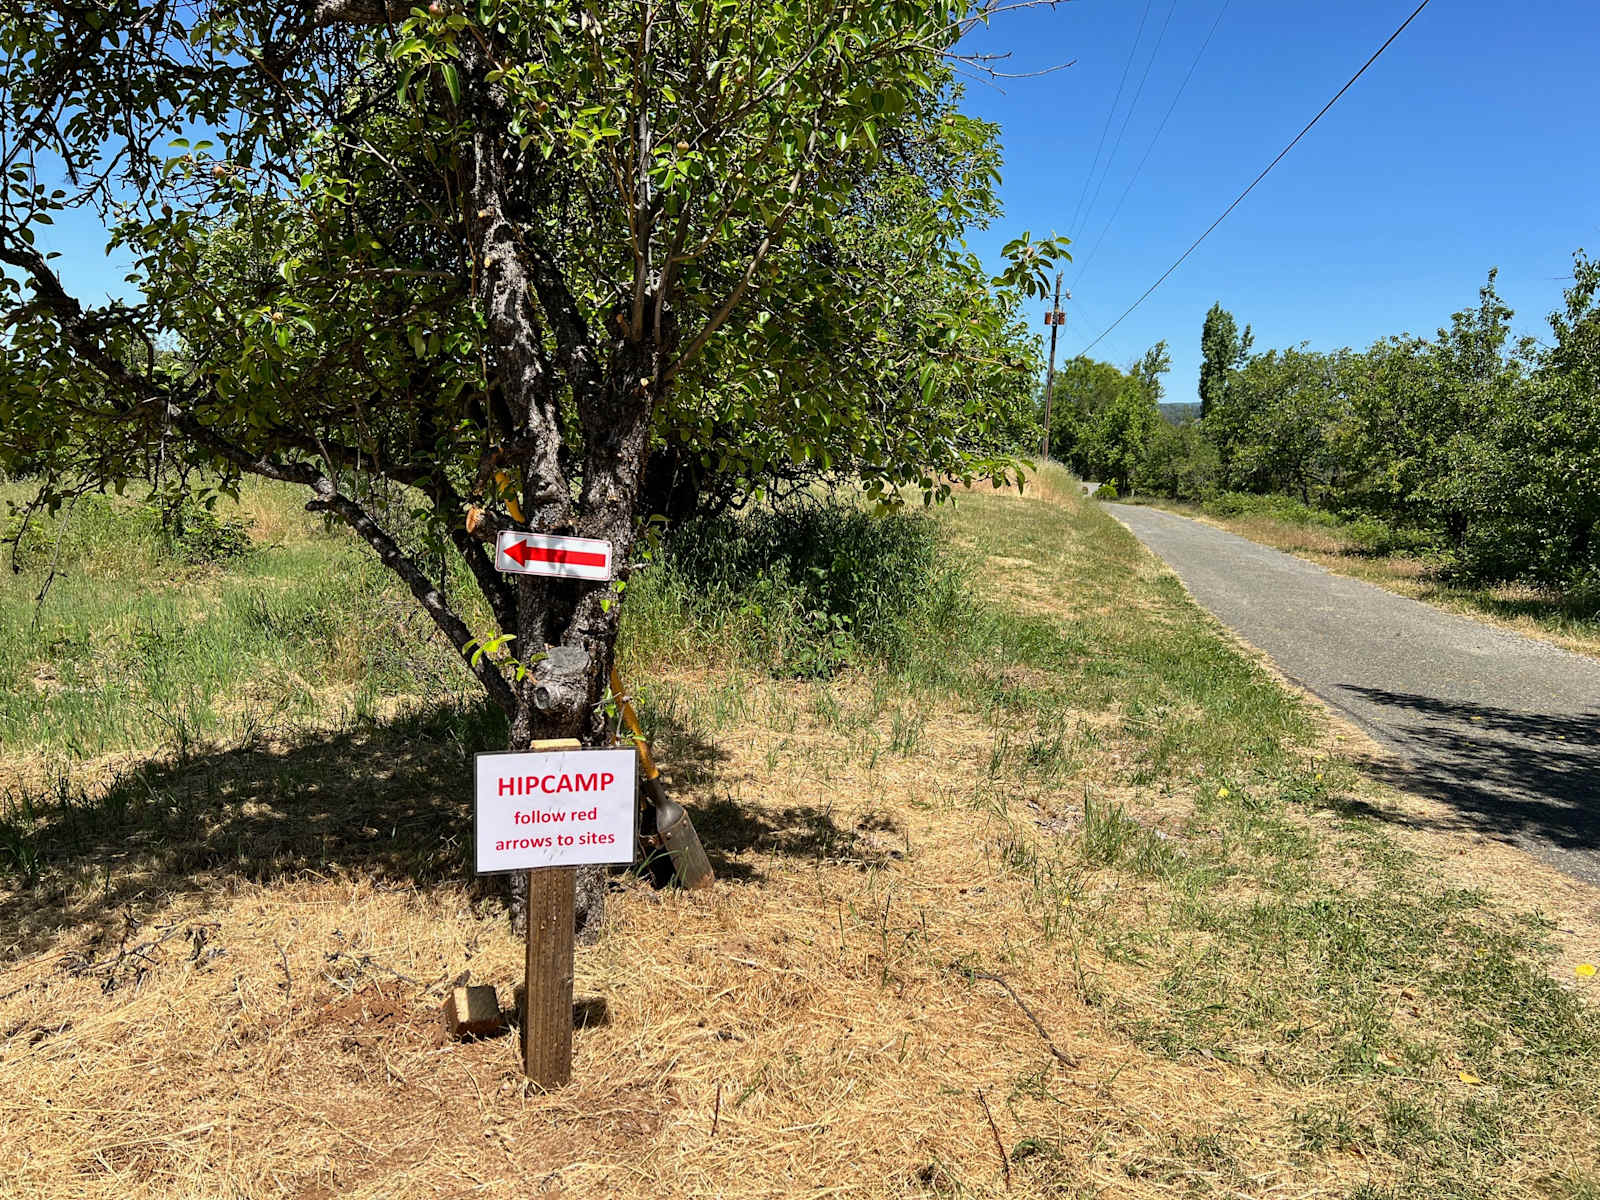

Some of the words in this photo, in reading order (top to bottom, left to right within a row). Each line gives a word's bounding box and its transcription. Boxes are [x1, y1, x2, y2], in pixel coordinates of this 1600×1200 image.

[498, 772, 614, 797] HIPCAMP
[514, 810, 566, 825] follow
[571, 807, 597, 821] red
[496, 836, 552, 851] arrows
[557, 833, 574, 846] to
[578, 831, 615, 845] sites
